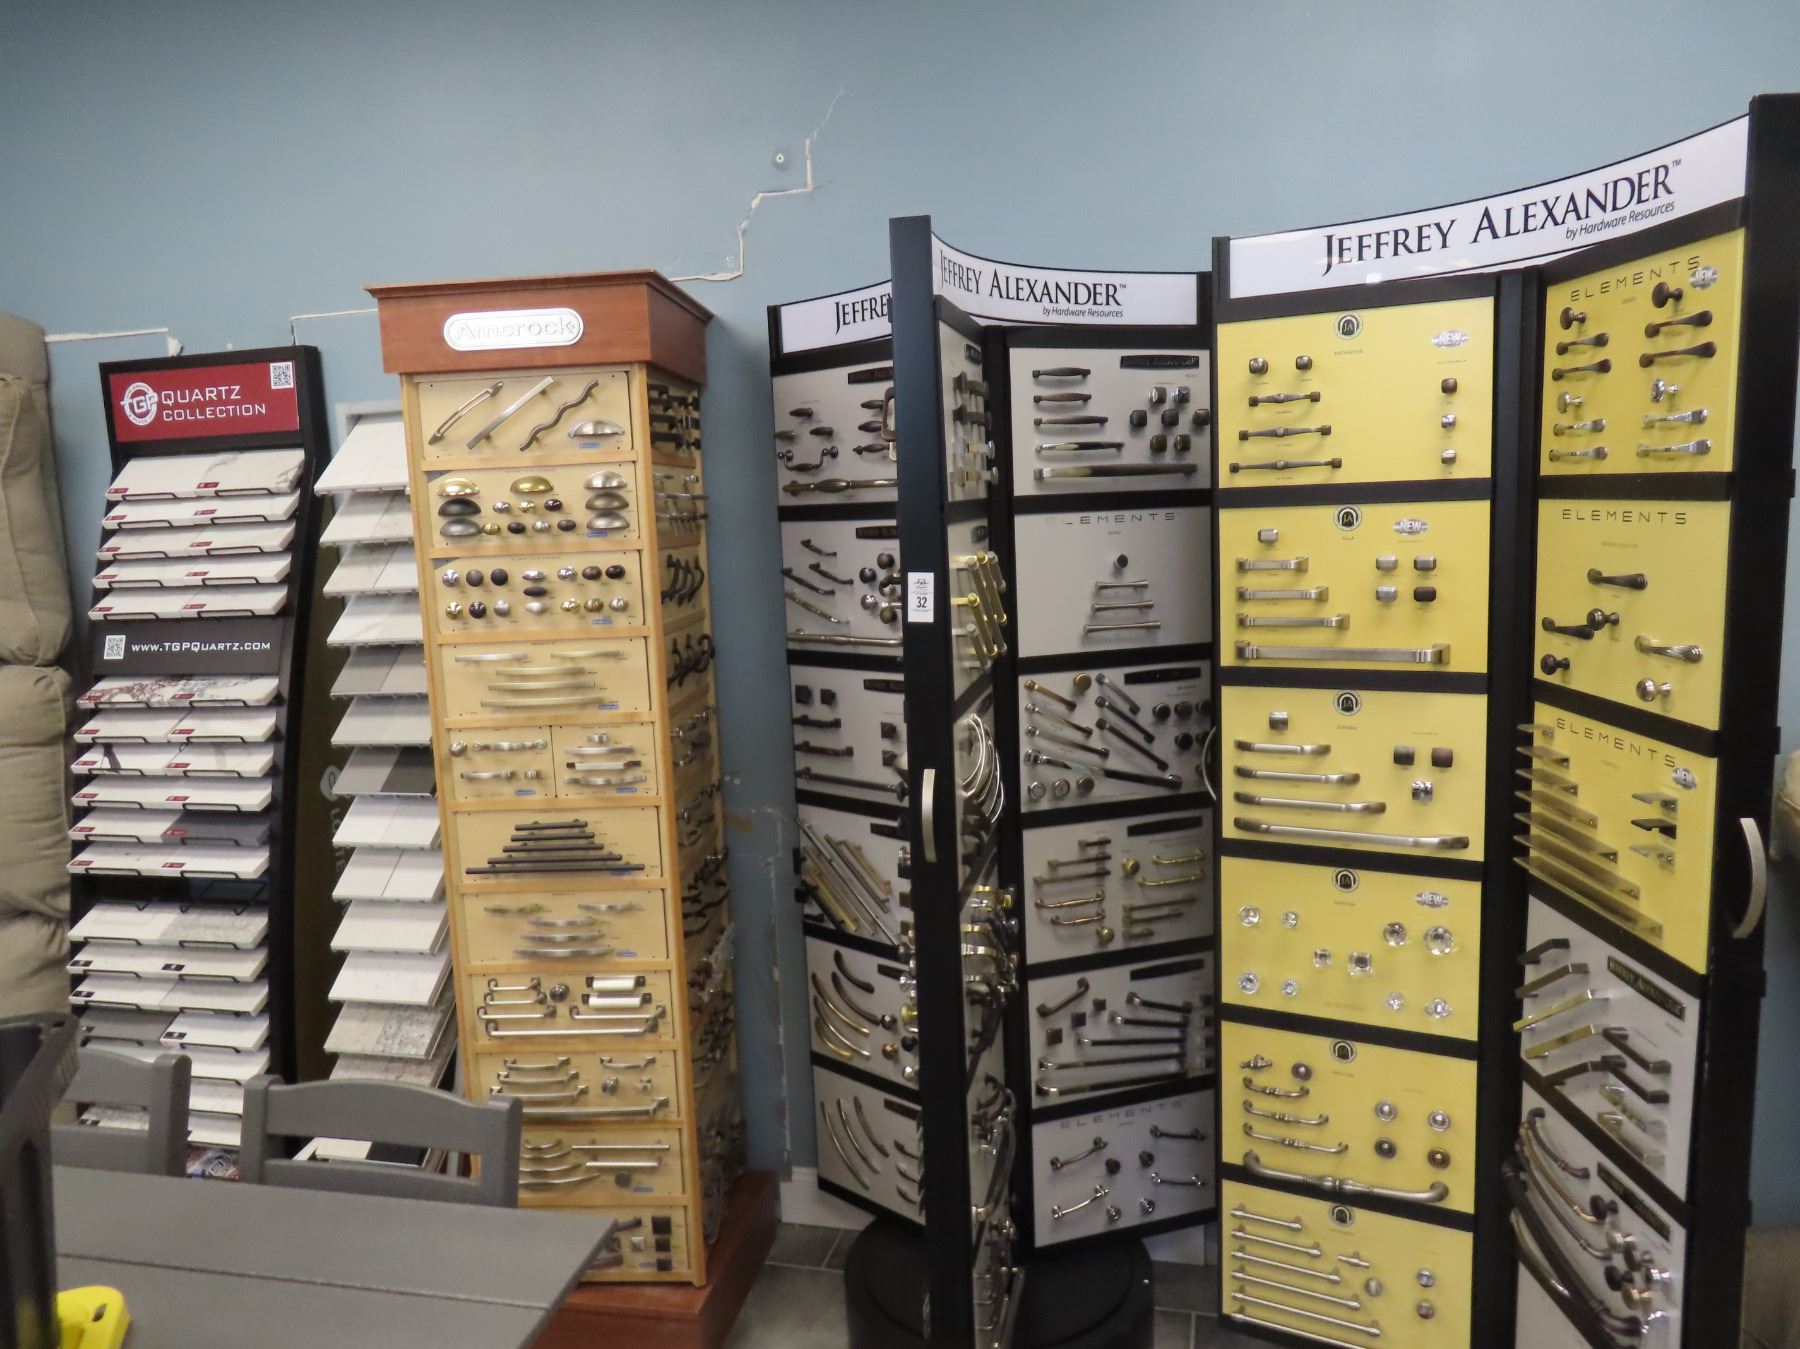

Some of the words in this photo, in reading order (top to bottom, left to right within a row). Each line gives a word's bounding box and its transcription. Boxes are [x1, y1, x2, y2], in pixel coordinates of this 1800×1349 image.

[1566, 226, 1578, 241] by
[1580, 215, 1627, 236] Hardware
[1629, 201, 1676, 223] Resources
[1322, 218, 1458, 277] JEFFREY
[940, 249, 982, 294] JEFFREY
[1570, 255, 1700, 302] ELEMENTS
[1042, 305, 1051, 317] by
[1052, 306, 1087, 317] Hardware
[1088, 307, 1124, 318] Resources
[161, 385, 242, 407] QUARTZ
[162, 403, 267, 423] COLLECTION
[1400, 519, 1422, 533] NEW
[1562, 508, 1688, 525] ELEMENTS
[916, 596, 928, 609] 32
[1556, 717, 1676, 769] ELEMENTS
